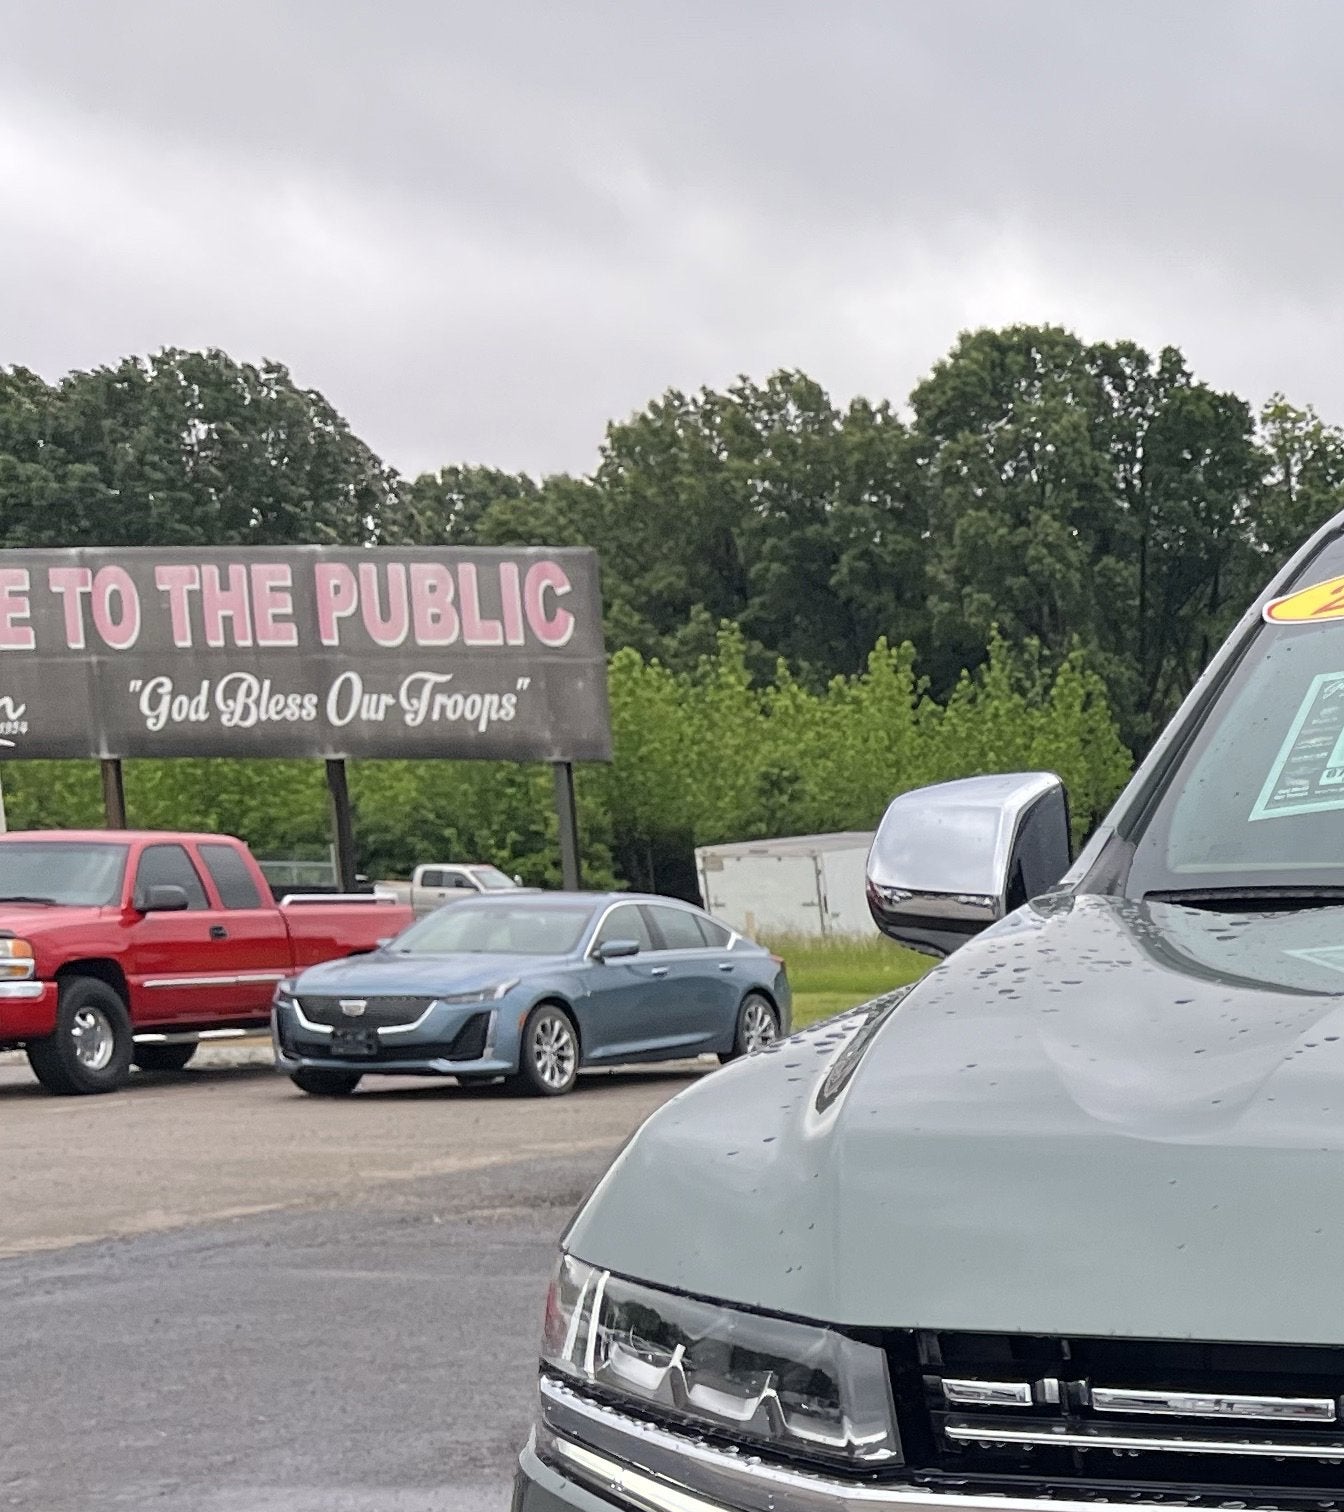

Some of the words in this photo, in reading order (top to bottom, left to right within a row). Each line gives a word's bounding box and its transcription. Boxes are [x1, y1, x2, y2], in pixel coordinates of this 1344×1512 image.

[48, 565, 141, 650] TO
[155, 563, 299, 648] THE
[314, 561, 574, 647] PUBLIC
[214, 671, 318, 728] Bless
[325, 670, 395, 727] Our
